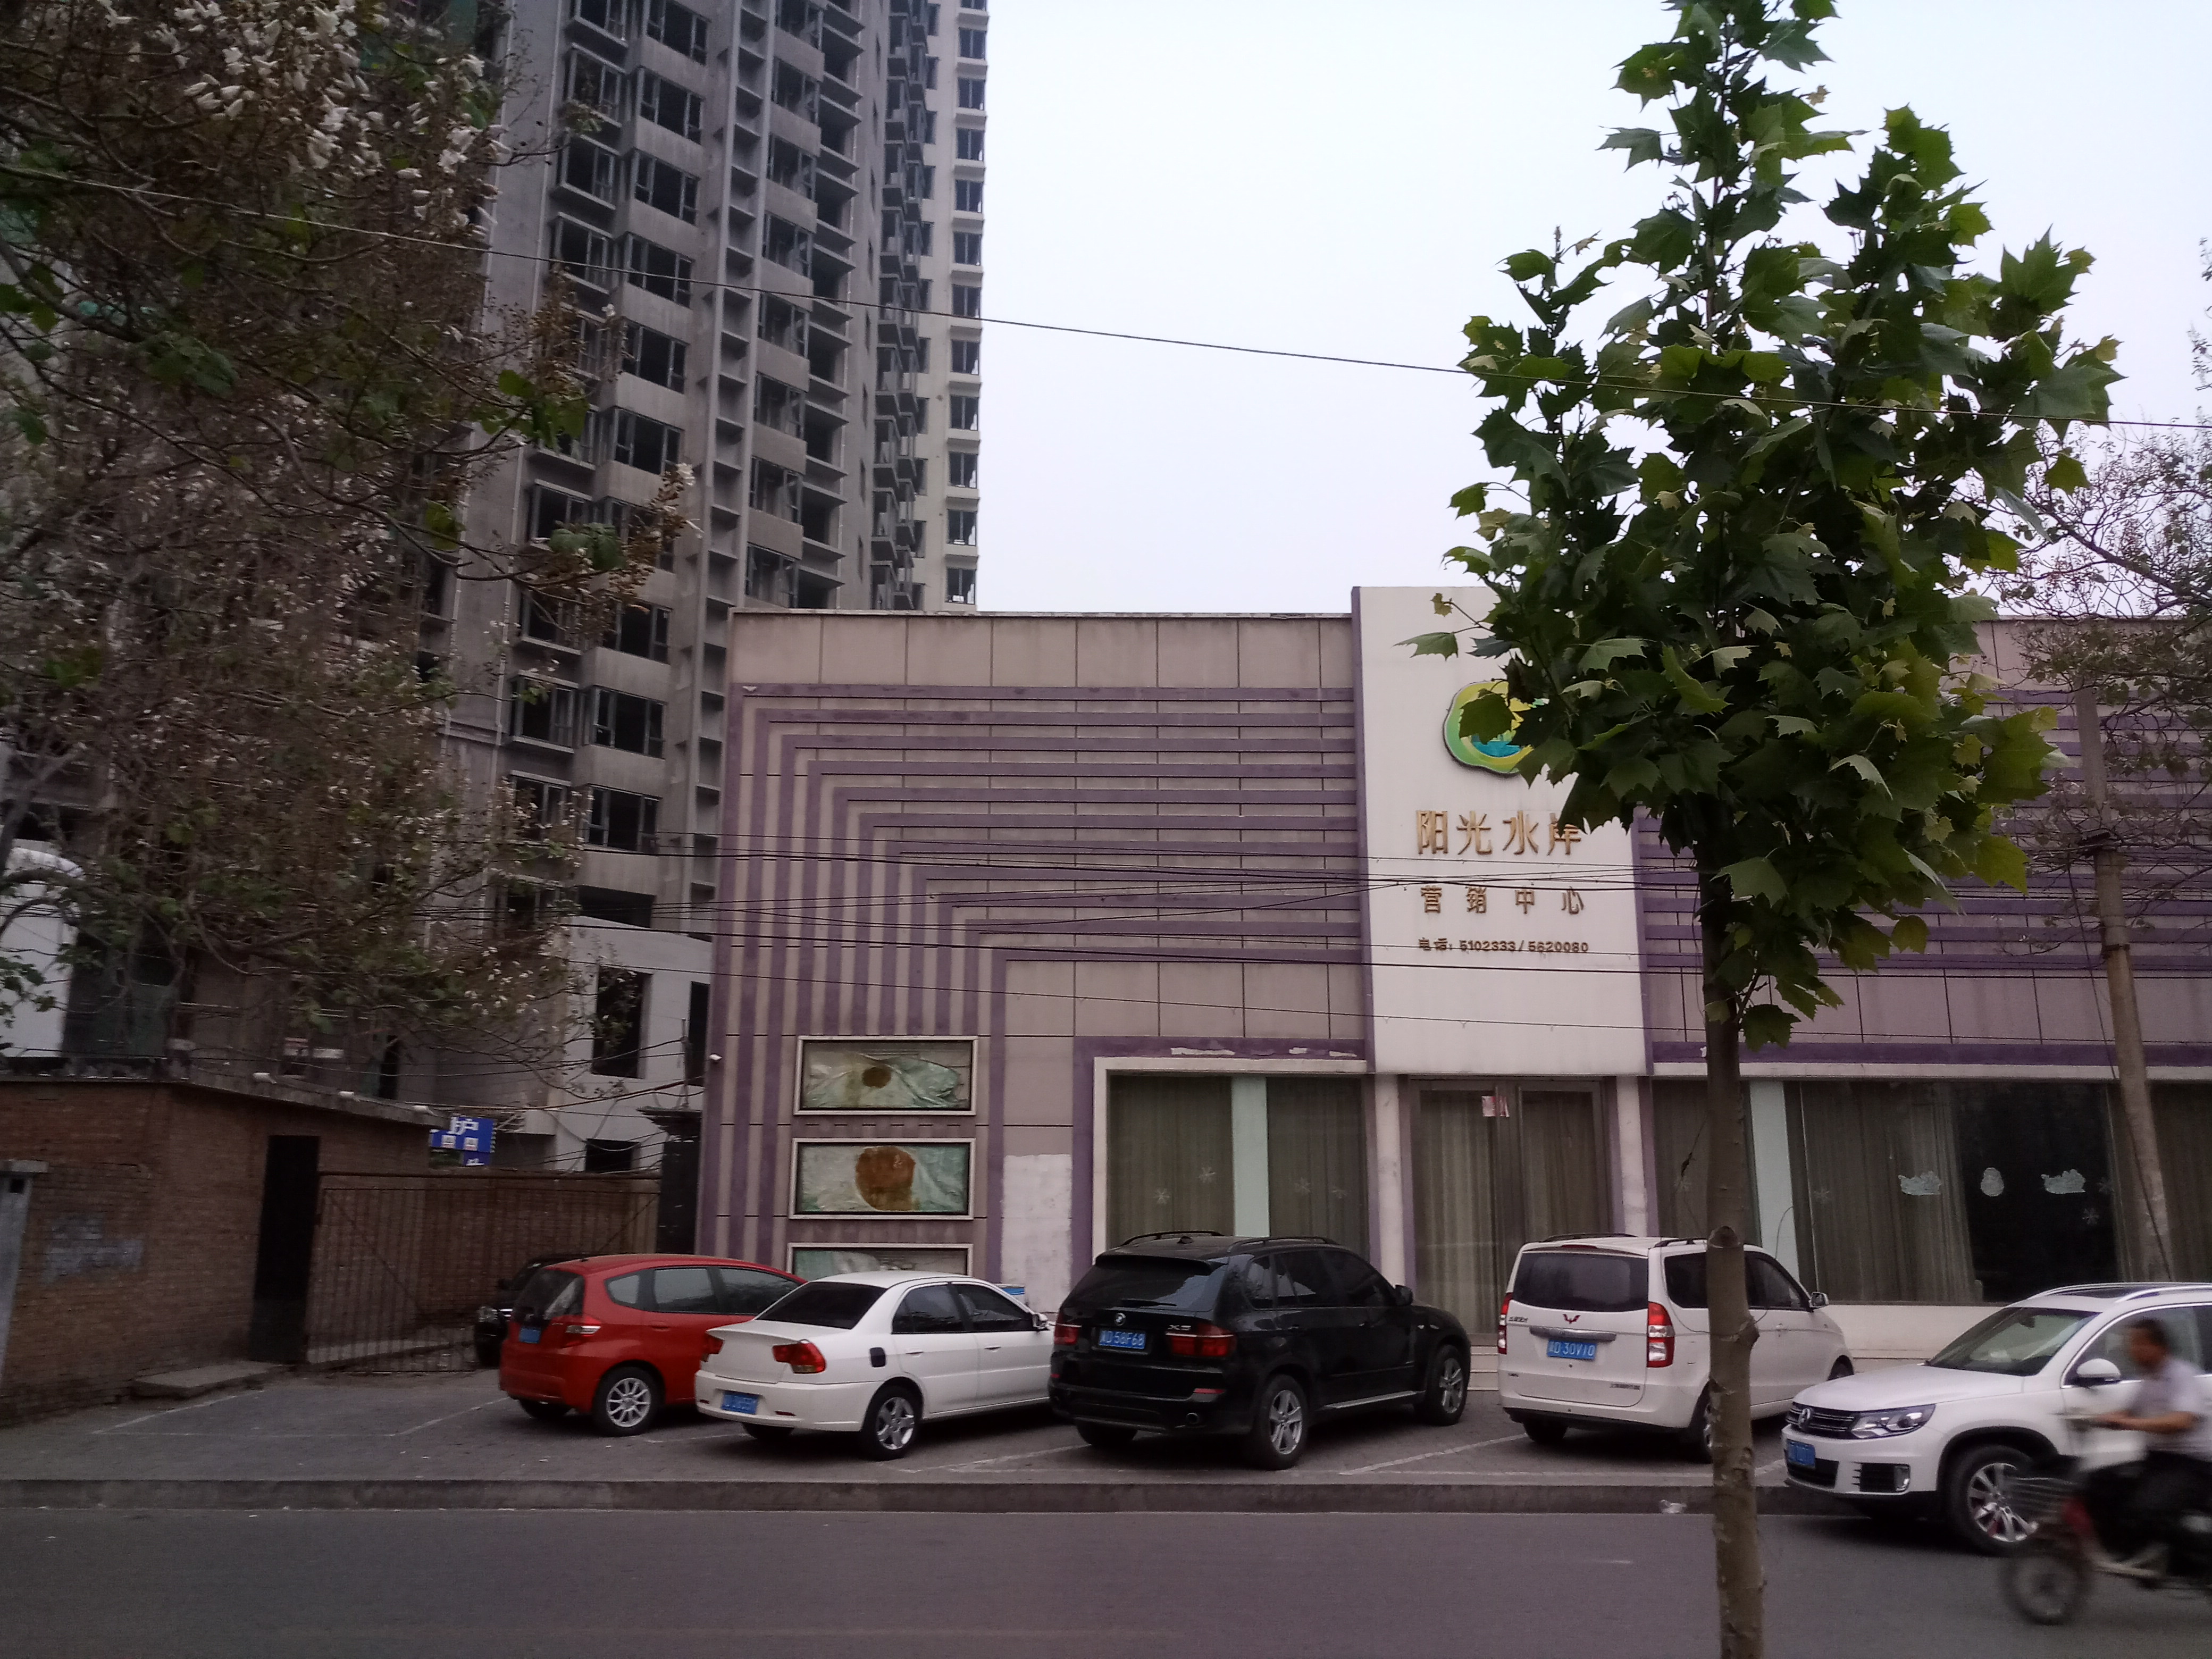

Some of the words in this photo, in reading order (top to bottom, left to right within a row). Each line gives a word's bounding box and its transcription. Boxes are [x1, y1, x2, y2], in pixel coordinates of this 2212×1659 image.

[1415, 810, 1582, 856] 阳光水岸
[1420, 885, 1585, 915] 营销中心
